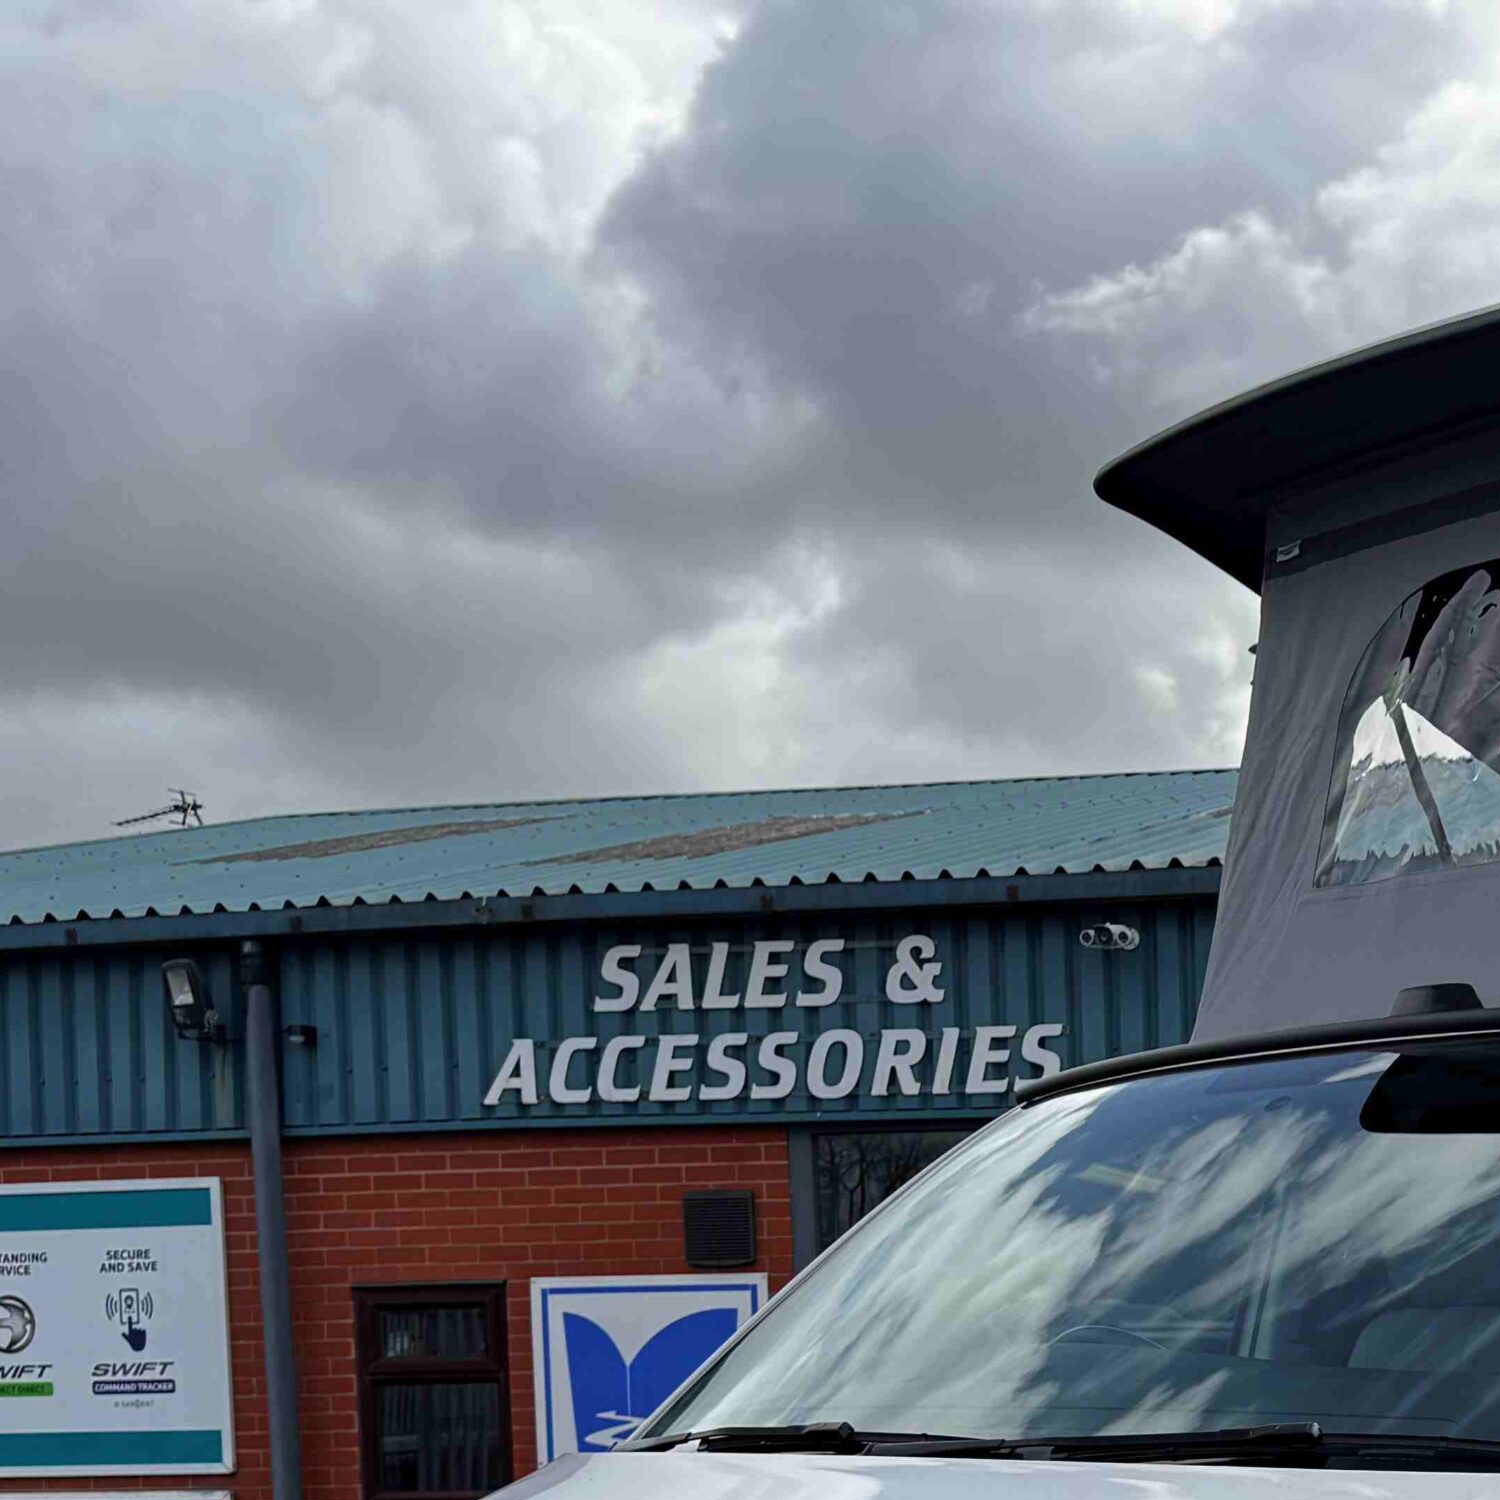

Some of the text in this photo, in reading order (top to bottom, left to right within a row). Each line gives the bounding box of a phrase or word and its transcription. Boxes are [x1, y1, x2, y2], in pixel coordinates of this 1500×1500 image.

[593, 934, 946, 1012] SALES &
[482, 1023, 1064, 1106] ACCESSORIES
[106, 1249, 151, 1261] SECURE
[100, 1261, 158, 1274] AND SAVE
[91, 1361, 175, 1378] SWIFT
[94, 1382, 174, 1393] COMMAND TRACKER
